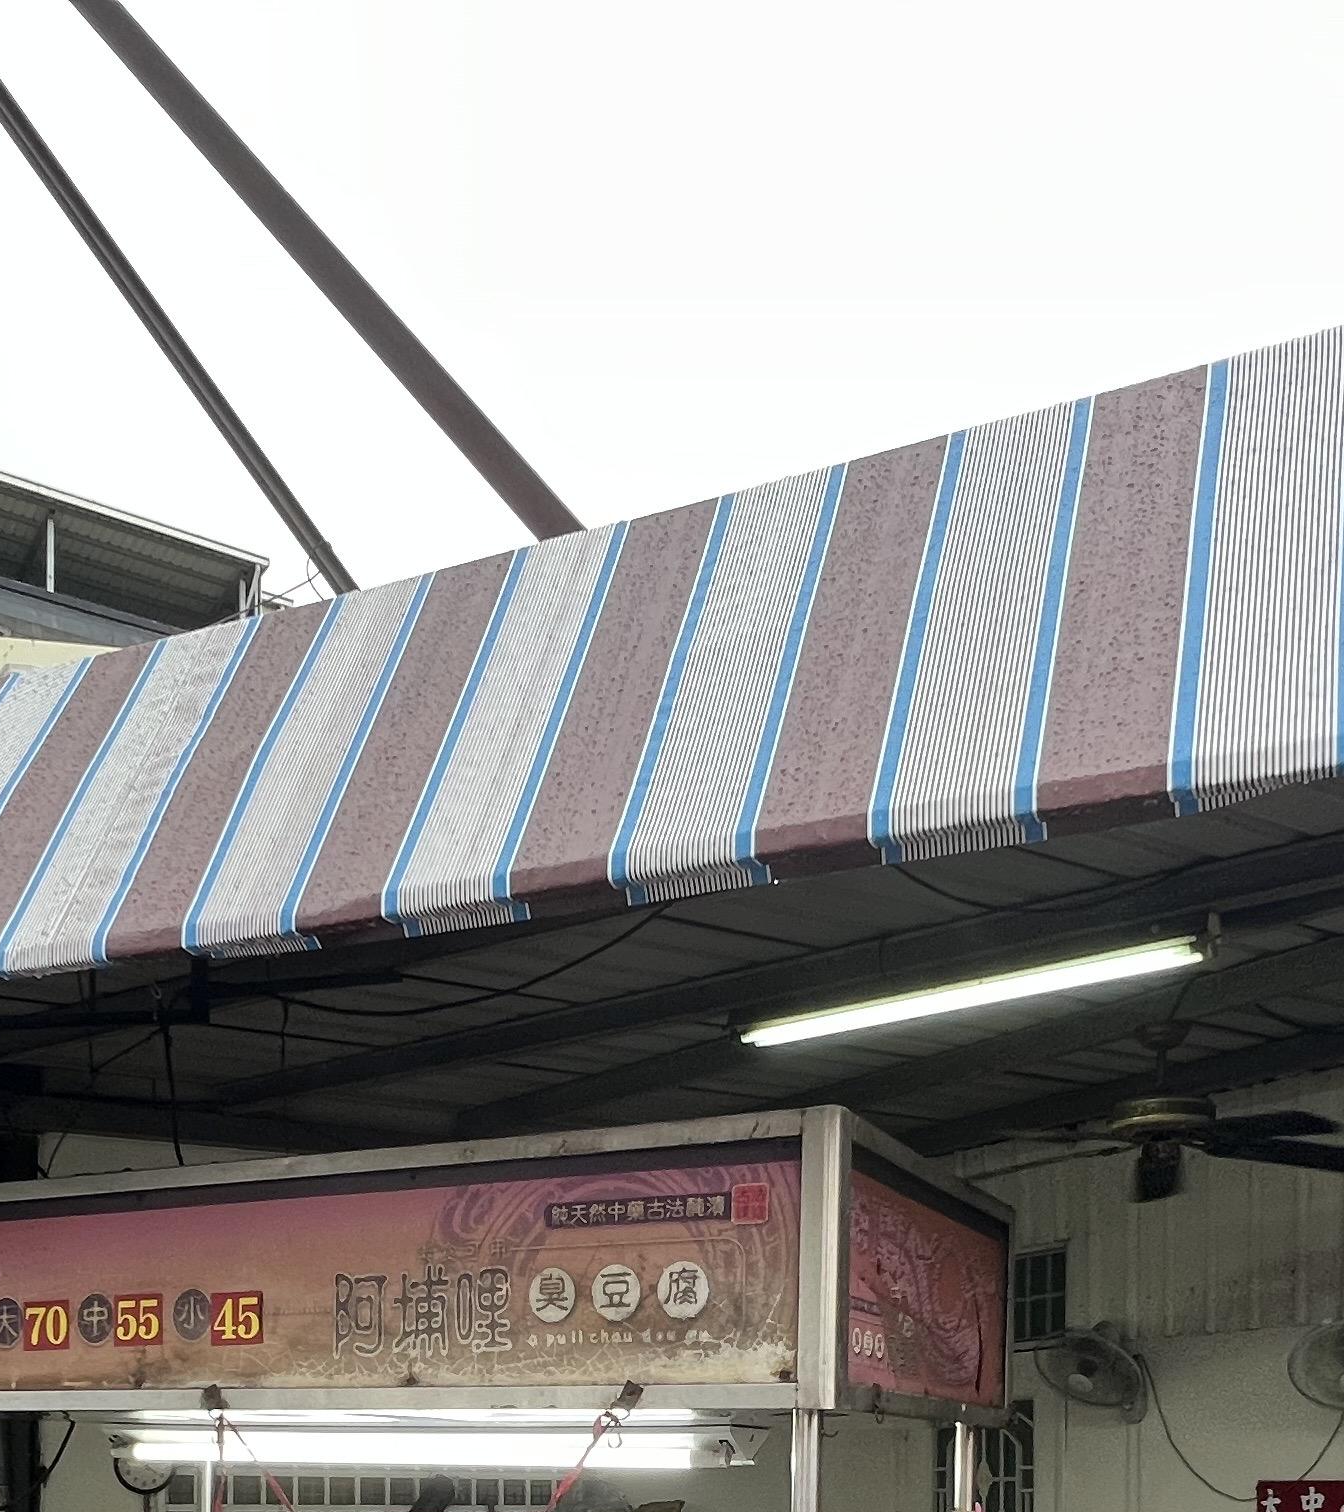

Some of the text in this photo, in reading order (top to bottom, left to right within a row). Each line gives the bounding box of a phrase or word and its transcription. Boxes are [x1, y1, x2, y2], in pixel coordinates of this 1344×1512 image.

[533, 1264, 703, 1315] 臭豆腐
[24, 1306, 67, 1346] 70
[82, 1303, 110, 1335] 中
[115, 1299, 160, 1341] 55
[179, 1296, 206, 1324] 小
[213, 1297, 260, 1340] 45
